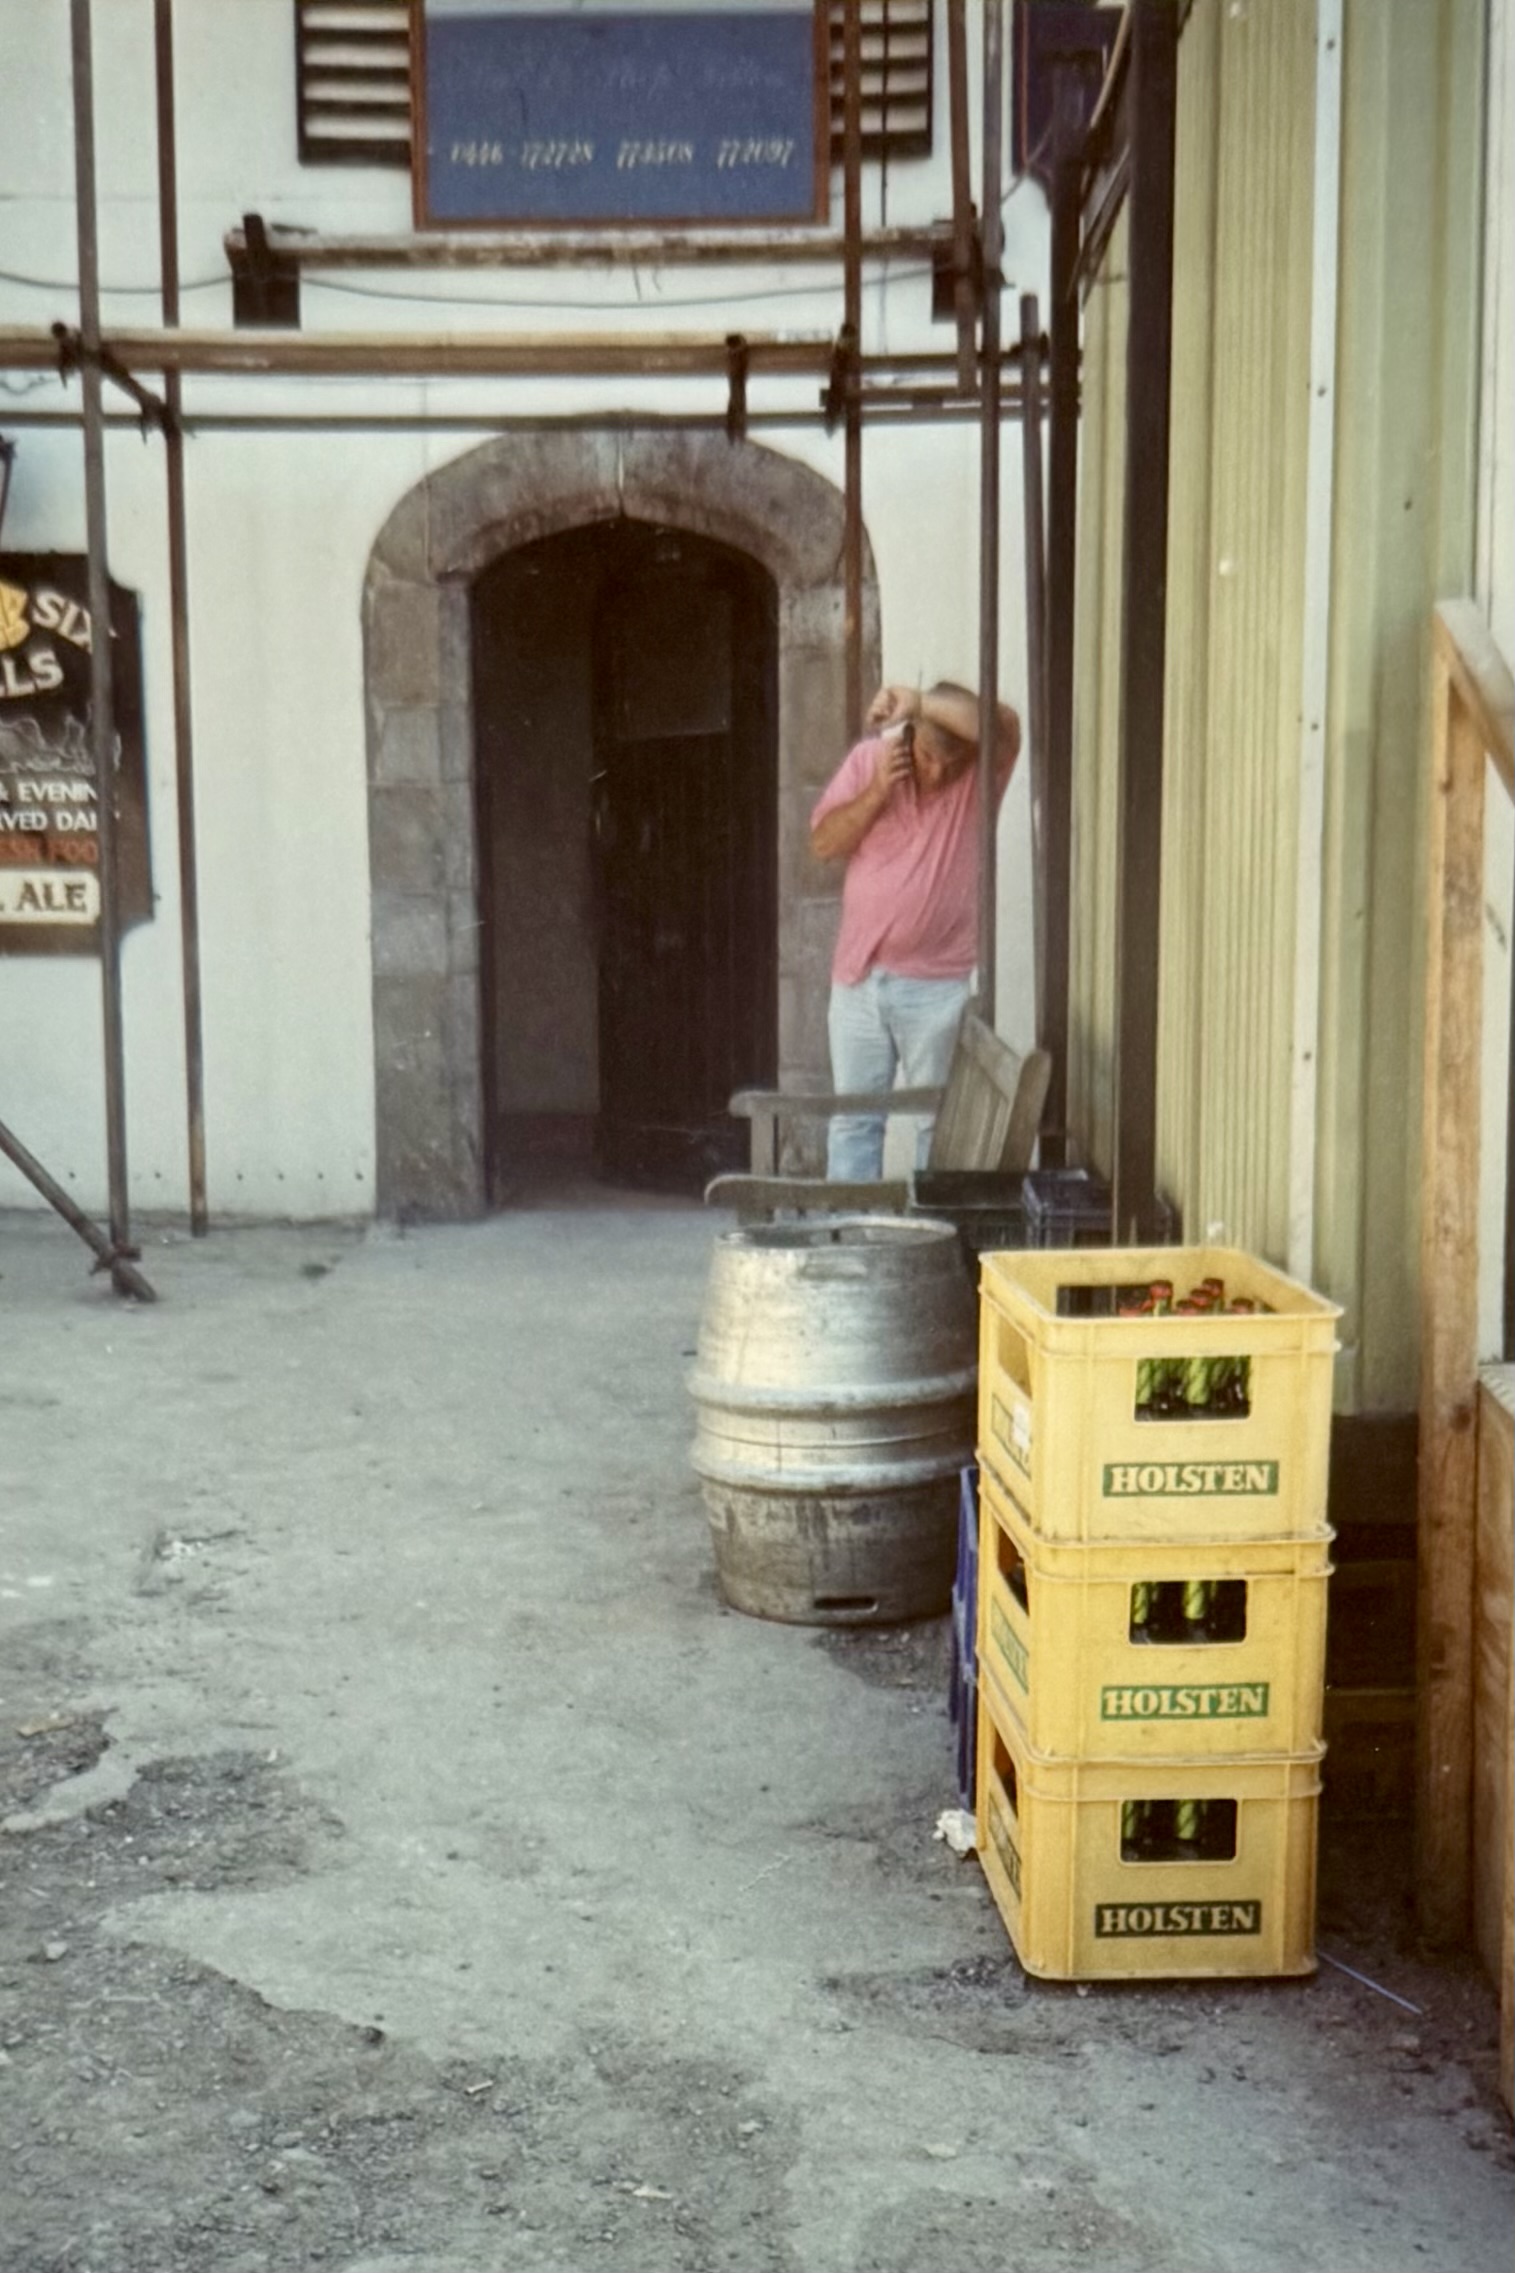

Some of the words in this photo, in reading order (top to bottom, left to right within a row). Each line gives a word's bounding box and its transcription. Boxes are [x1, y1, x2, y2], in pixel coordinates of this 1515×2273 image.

[0, 648, 64, 697] LS
[0, 811, 48, 831] VED
[16, 881, 87, 912] ALE
[1110, 1464, 1270, 1494] HOLSTEN
[1103, 1687, 1265, 1717] HOLSTEN
[1101, 1905, 1256, 1933] HOLSTEN
